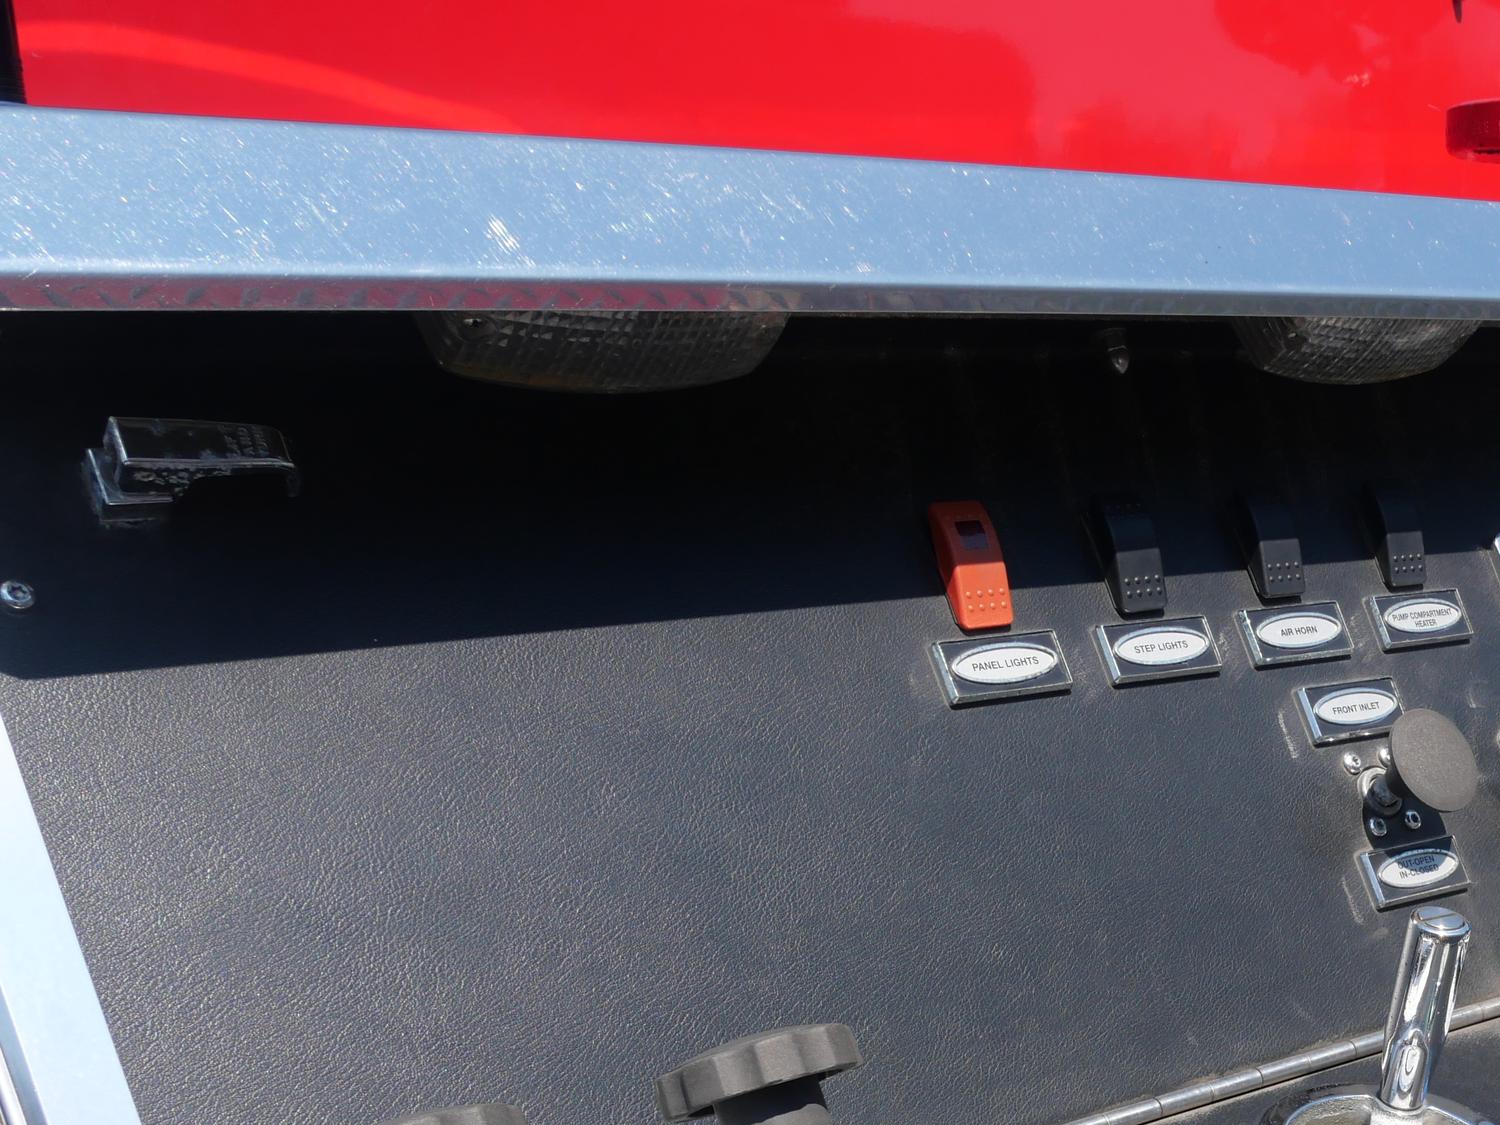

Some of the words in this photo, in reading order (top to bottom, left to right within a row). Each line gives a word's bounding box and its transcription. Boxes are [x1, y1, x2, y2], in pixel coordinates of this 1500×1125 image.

[1392, 612, 1409, 621] PUMP
[1410, 608, 1452, 620] COMPARTMENT
[1414, 618, 1437, 628] HEATER
[1280, 626, 1294, 637] AIR
[1295, 626, 1318, 636] HORN
[1134, 642, 1157, 654] STEP
[1159, 640, 1189, 652] LIGHTS
[971, 659, 1003, 672] PANEL
[1005, 655, 1039, 670] LIGHTS
[1332, 703, 1358, 716] FRONT
[1359, 701, 1381, 712] INLET
[1398, 855, 1435, 869] OUT-OPEN
[1400, 864, 1439, 880] IN-CLOSED
